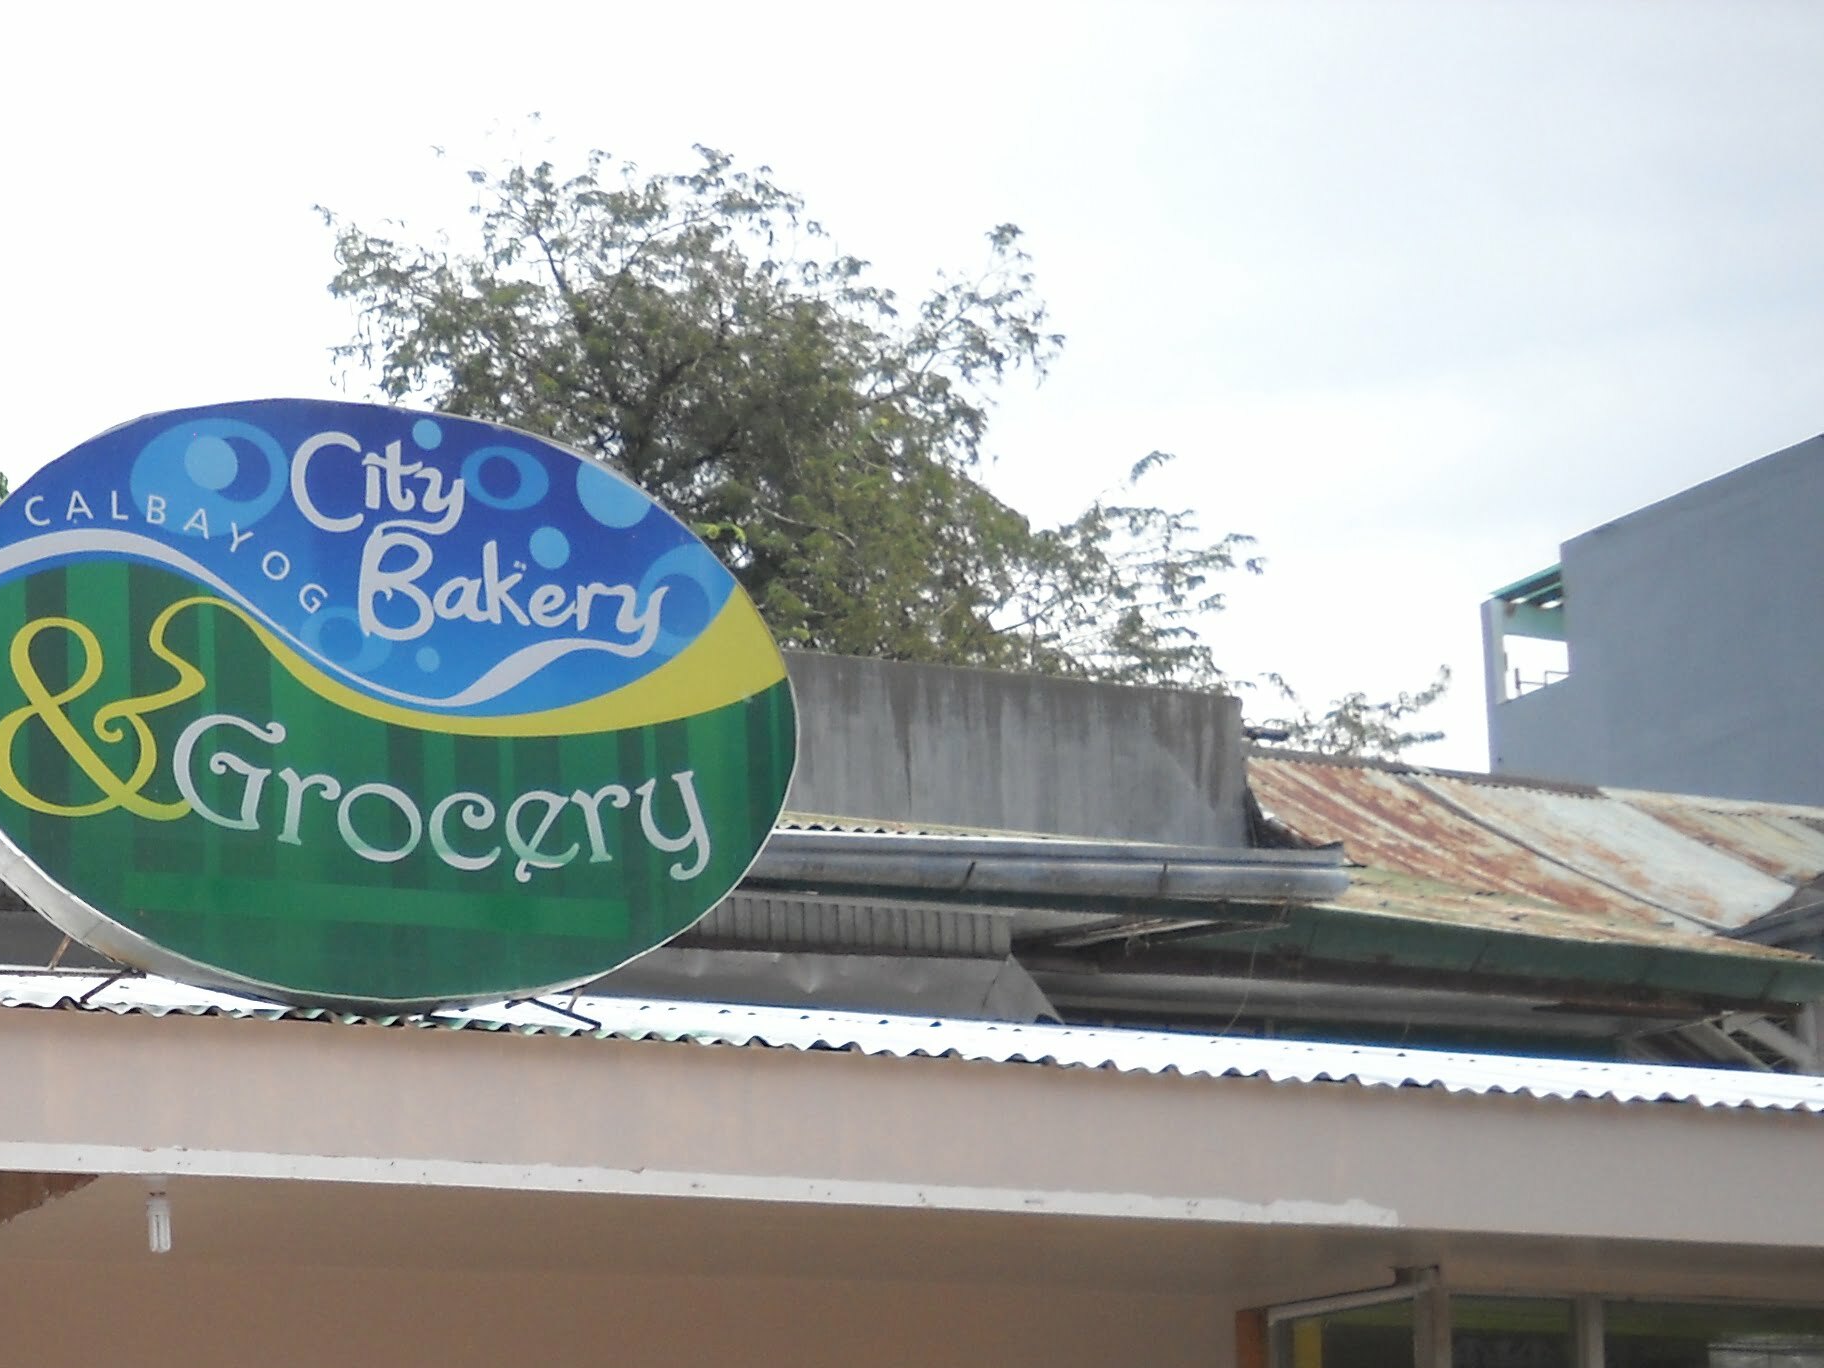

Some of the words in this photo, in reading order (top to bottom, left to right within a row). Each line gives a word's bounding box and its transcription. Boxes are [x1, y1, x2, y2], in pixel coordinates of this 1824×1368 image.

[290, 430, 466, 536] City
[24, 490, 329, 615] CALBAYOG
[356, 519, 670, 659] Bakery
[172, 712, 713, 882] Grocery
